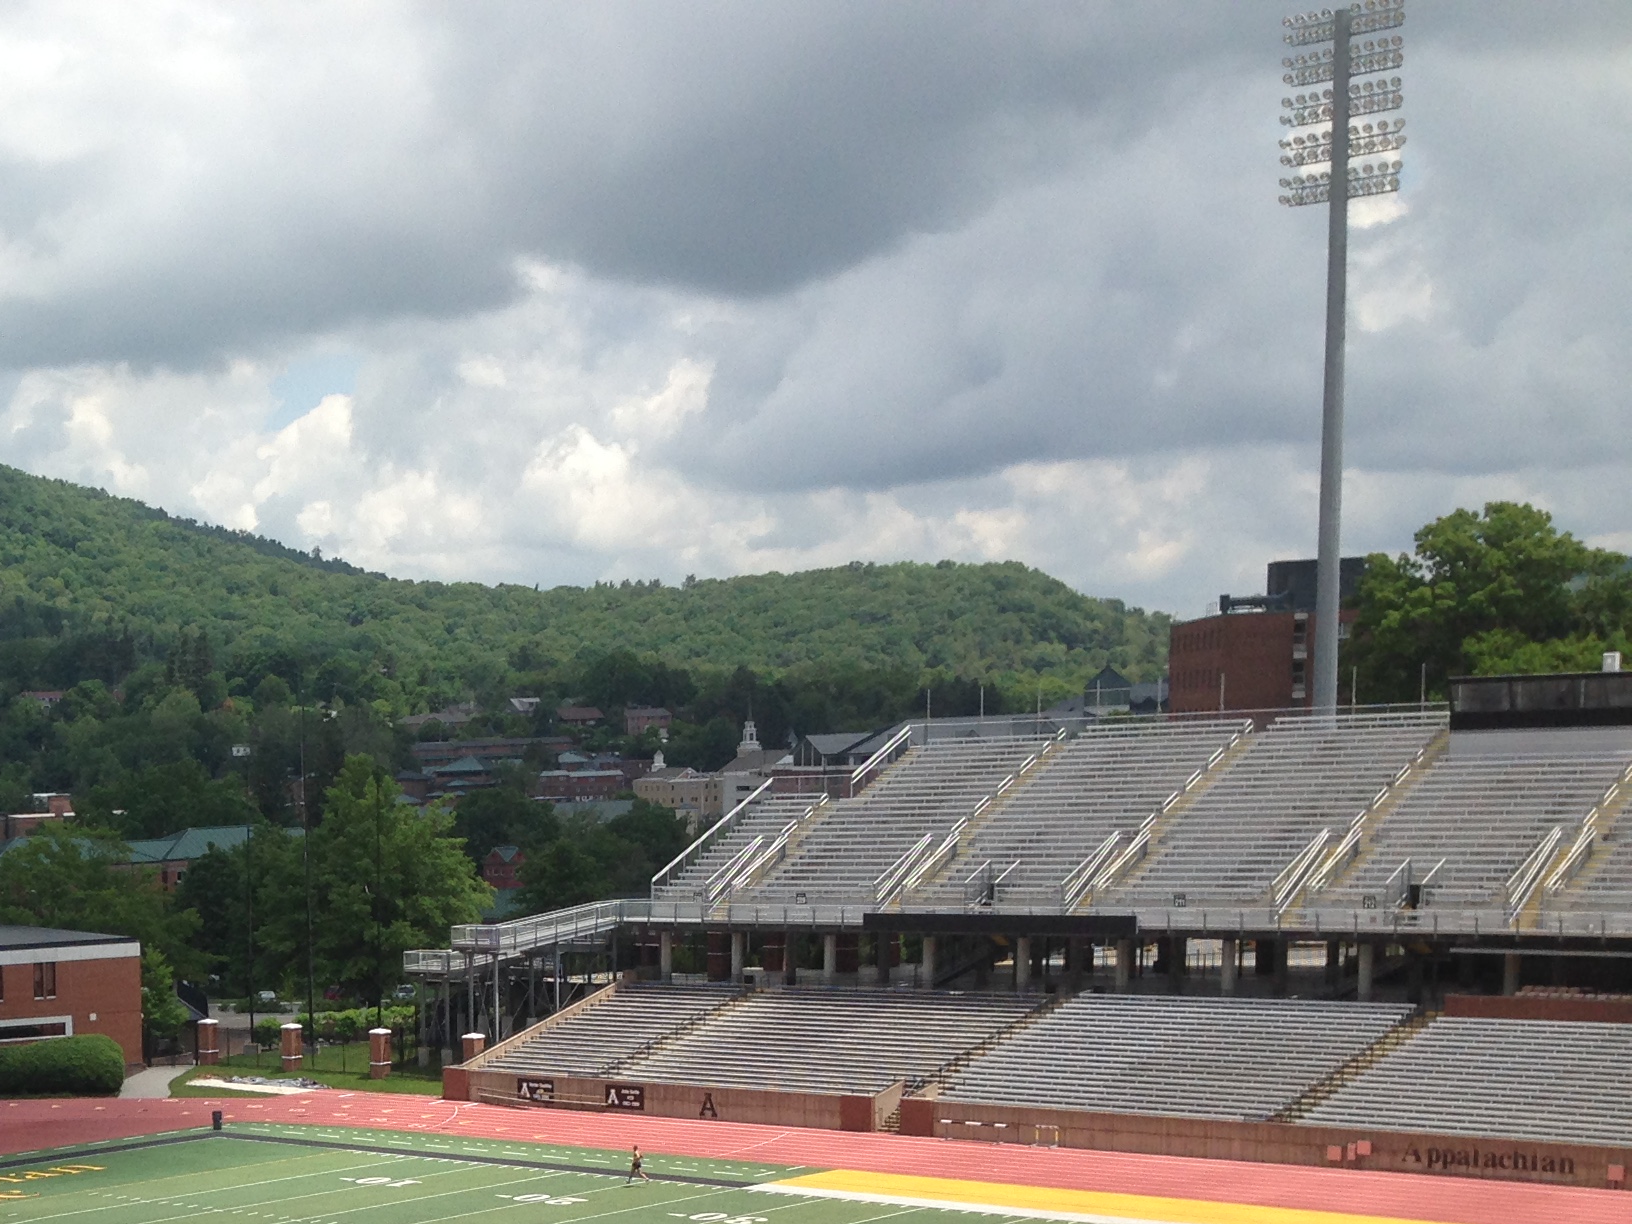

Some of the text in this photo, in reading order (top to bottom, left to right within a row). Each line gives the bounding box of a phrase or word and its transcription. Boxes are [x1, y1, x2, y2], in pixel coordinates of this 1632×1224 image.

[520, 1082, 531, 1098] A
[607, 1089, 619, 1104] A
[699, 1093, 717, 1117] A
[1401, 1143, 1576, 1176] Appalachian
[354, 1176, 422, 1188] 10
[511, 1193, 590, 1206] 20
[688, 1212, 768, 1224] 30
